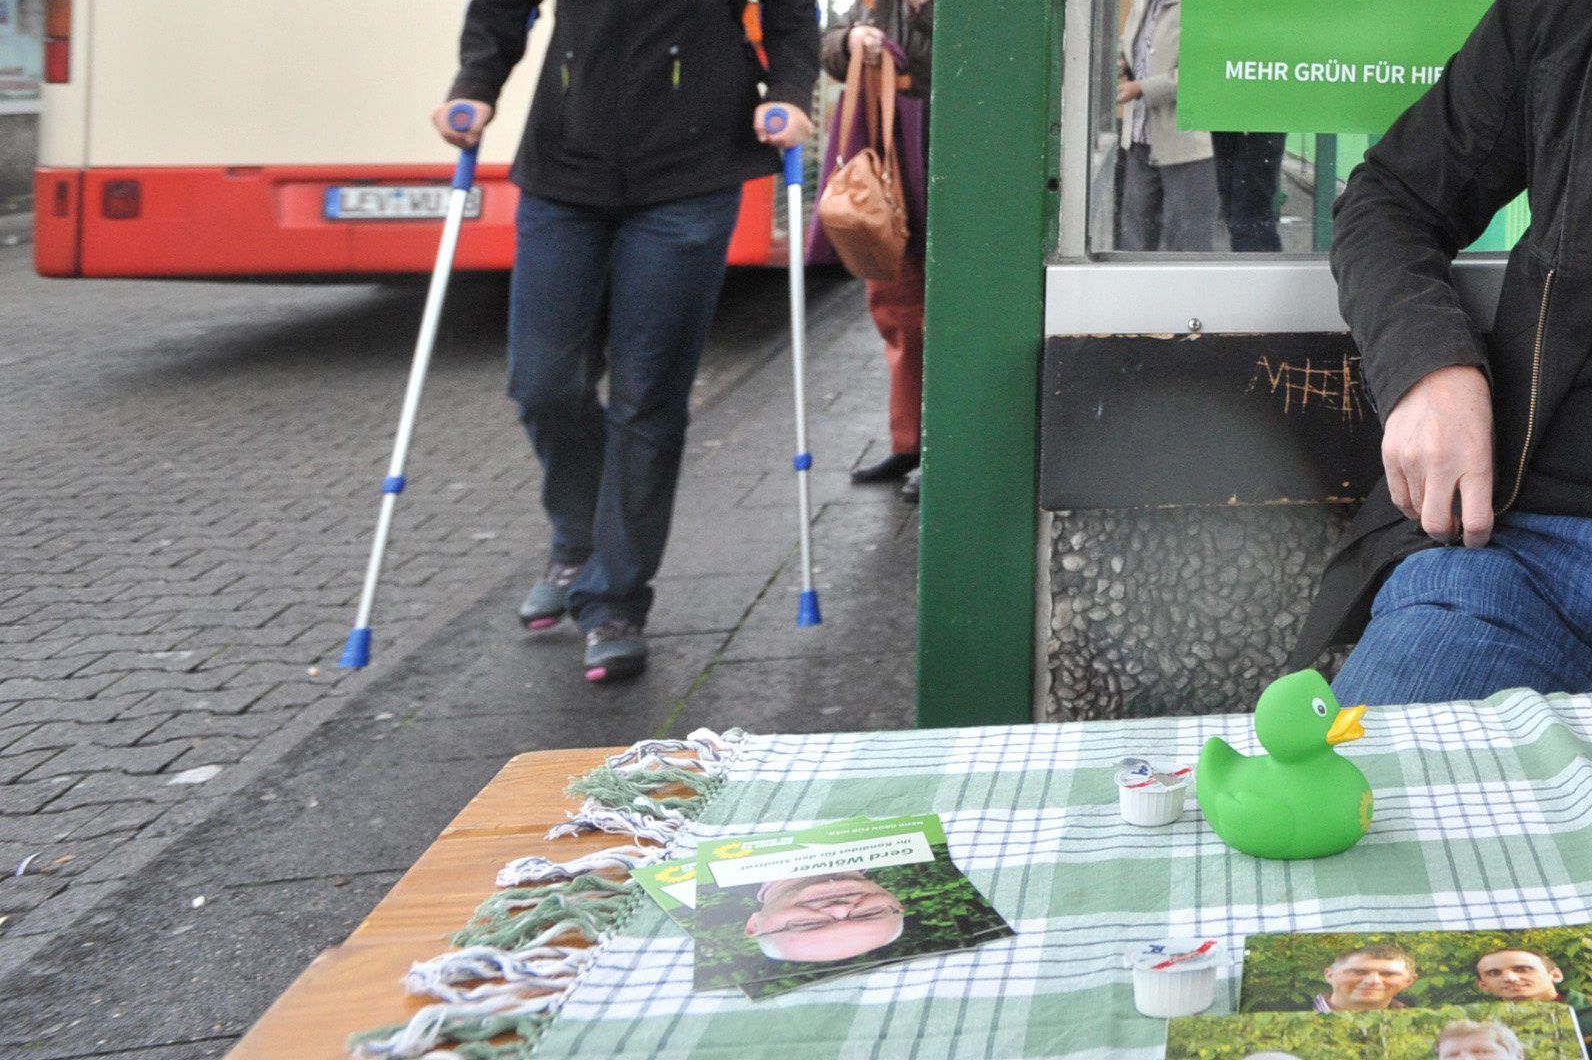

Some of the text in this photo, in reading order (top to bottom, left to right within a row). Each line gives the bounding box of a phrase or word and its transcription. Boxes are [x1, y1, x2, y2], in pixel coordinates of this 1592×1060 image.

[1225, 60, 1288, 81] MEHR
[1294, 59, 1356, 83] GRÜN
[1363, 61, 1405, 84] FÜR
[869, 848, 914, 862] Gerd
